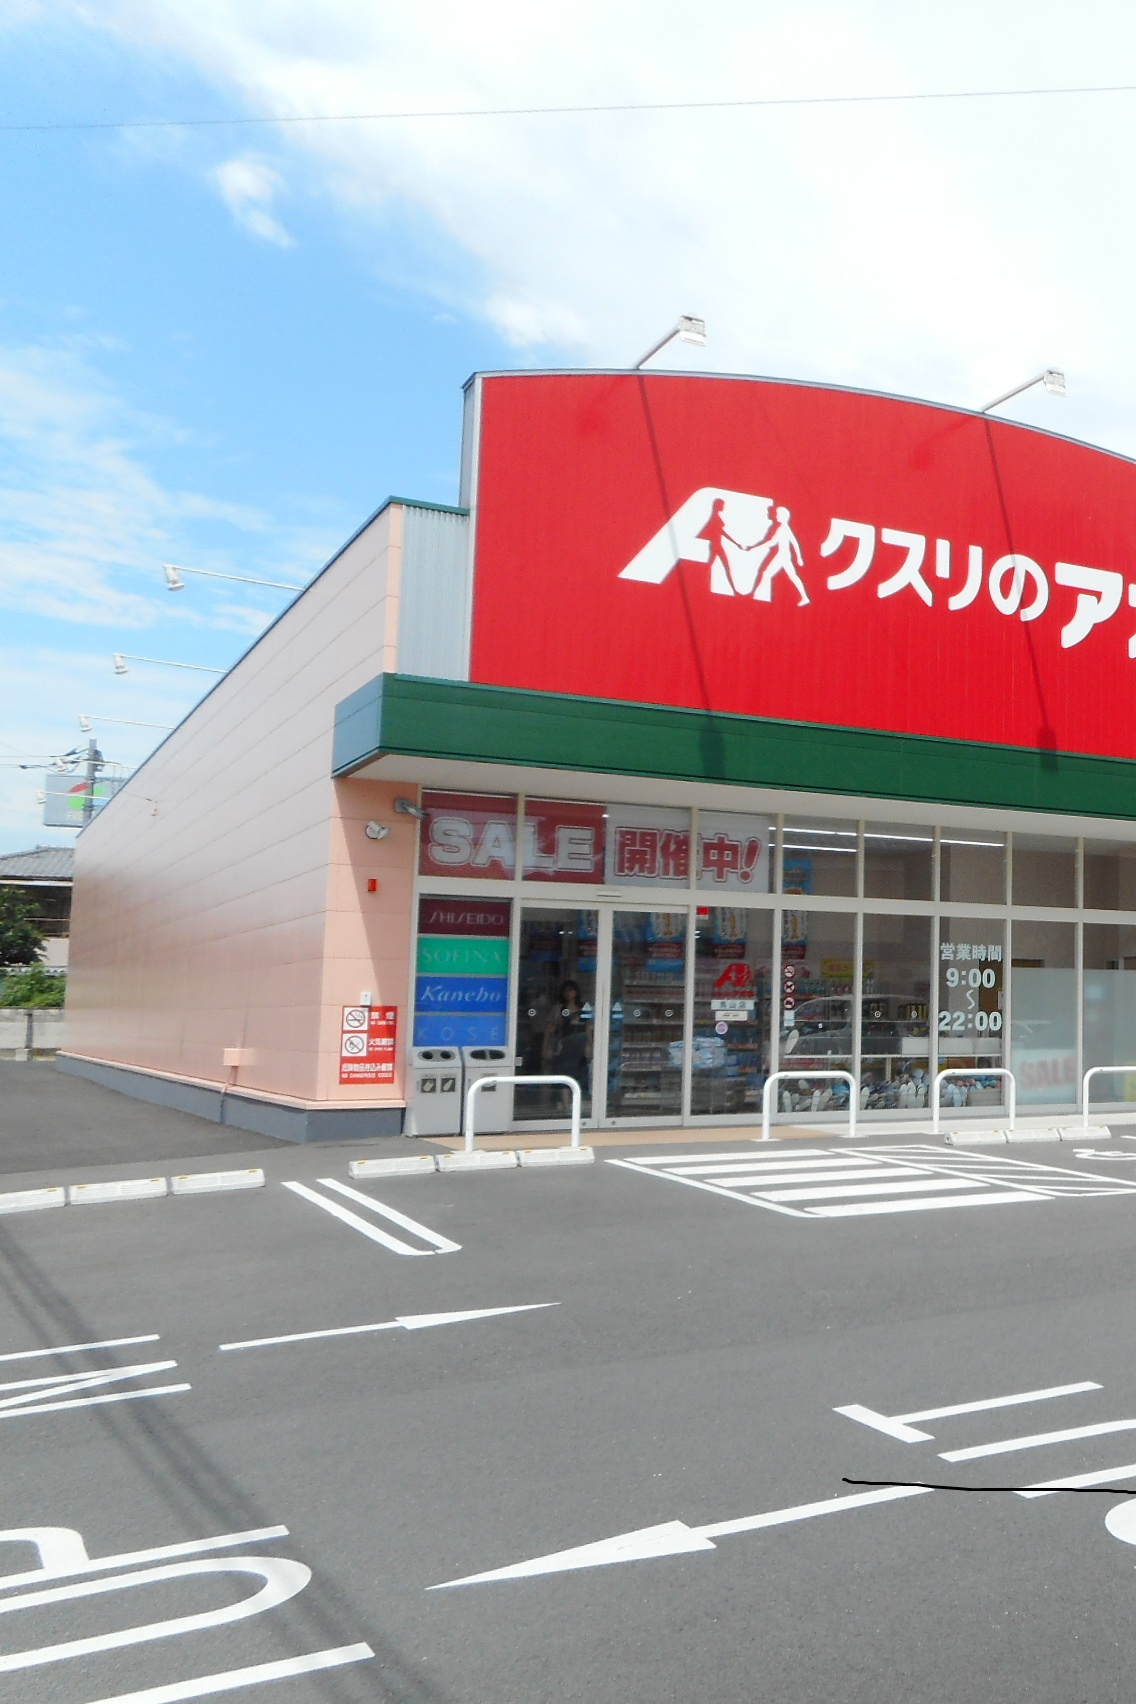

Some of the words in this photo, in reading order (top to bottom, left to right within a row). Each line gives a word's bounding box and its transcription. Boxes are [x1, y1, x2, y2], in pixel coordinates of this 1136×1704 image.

[429, 817, 595, 872] SALE
[430, 911, 504, 926] SHISEIDO
[421, 947, 502, 964] SOFINA
[940, 943, 1002, 961] 営業時間
[946, 968, 996, 988] 9:00
[421, 985, 502, 1002] Kanebo
[938, 1010, 1002, 1031] 22:00
